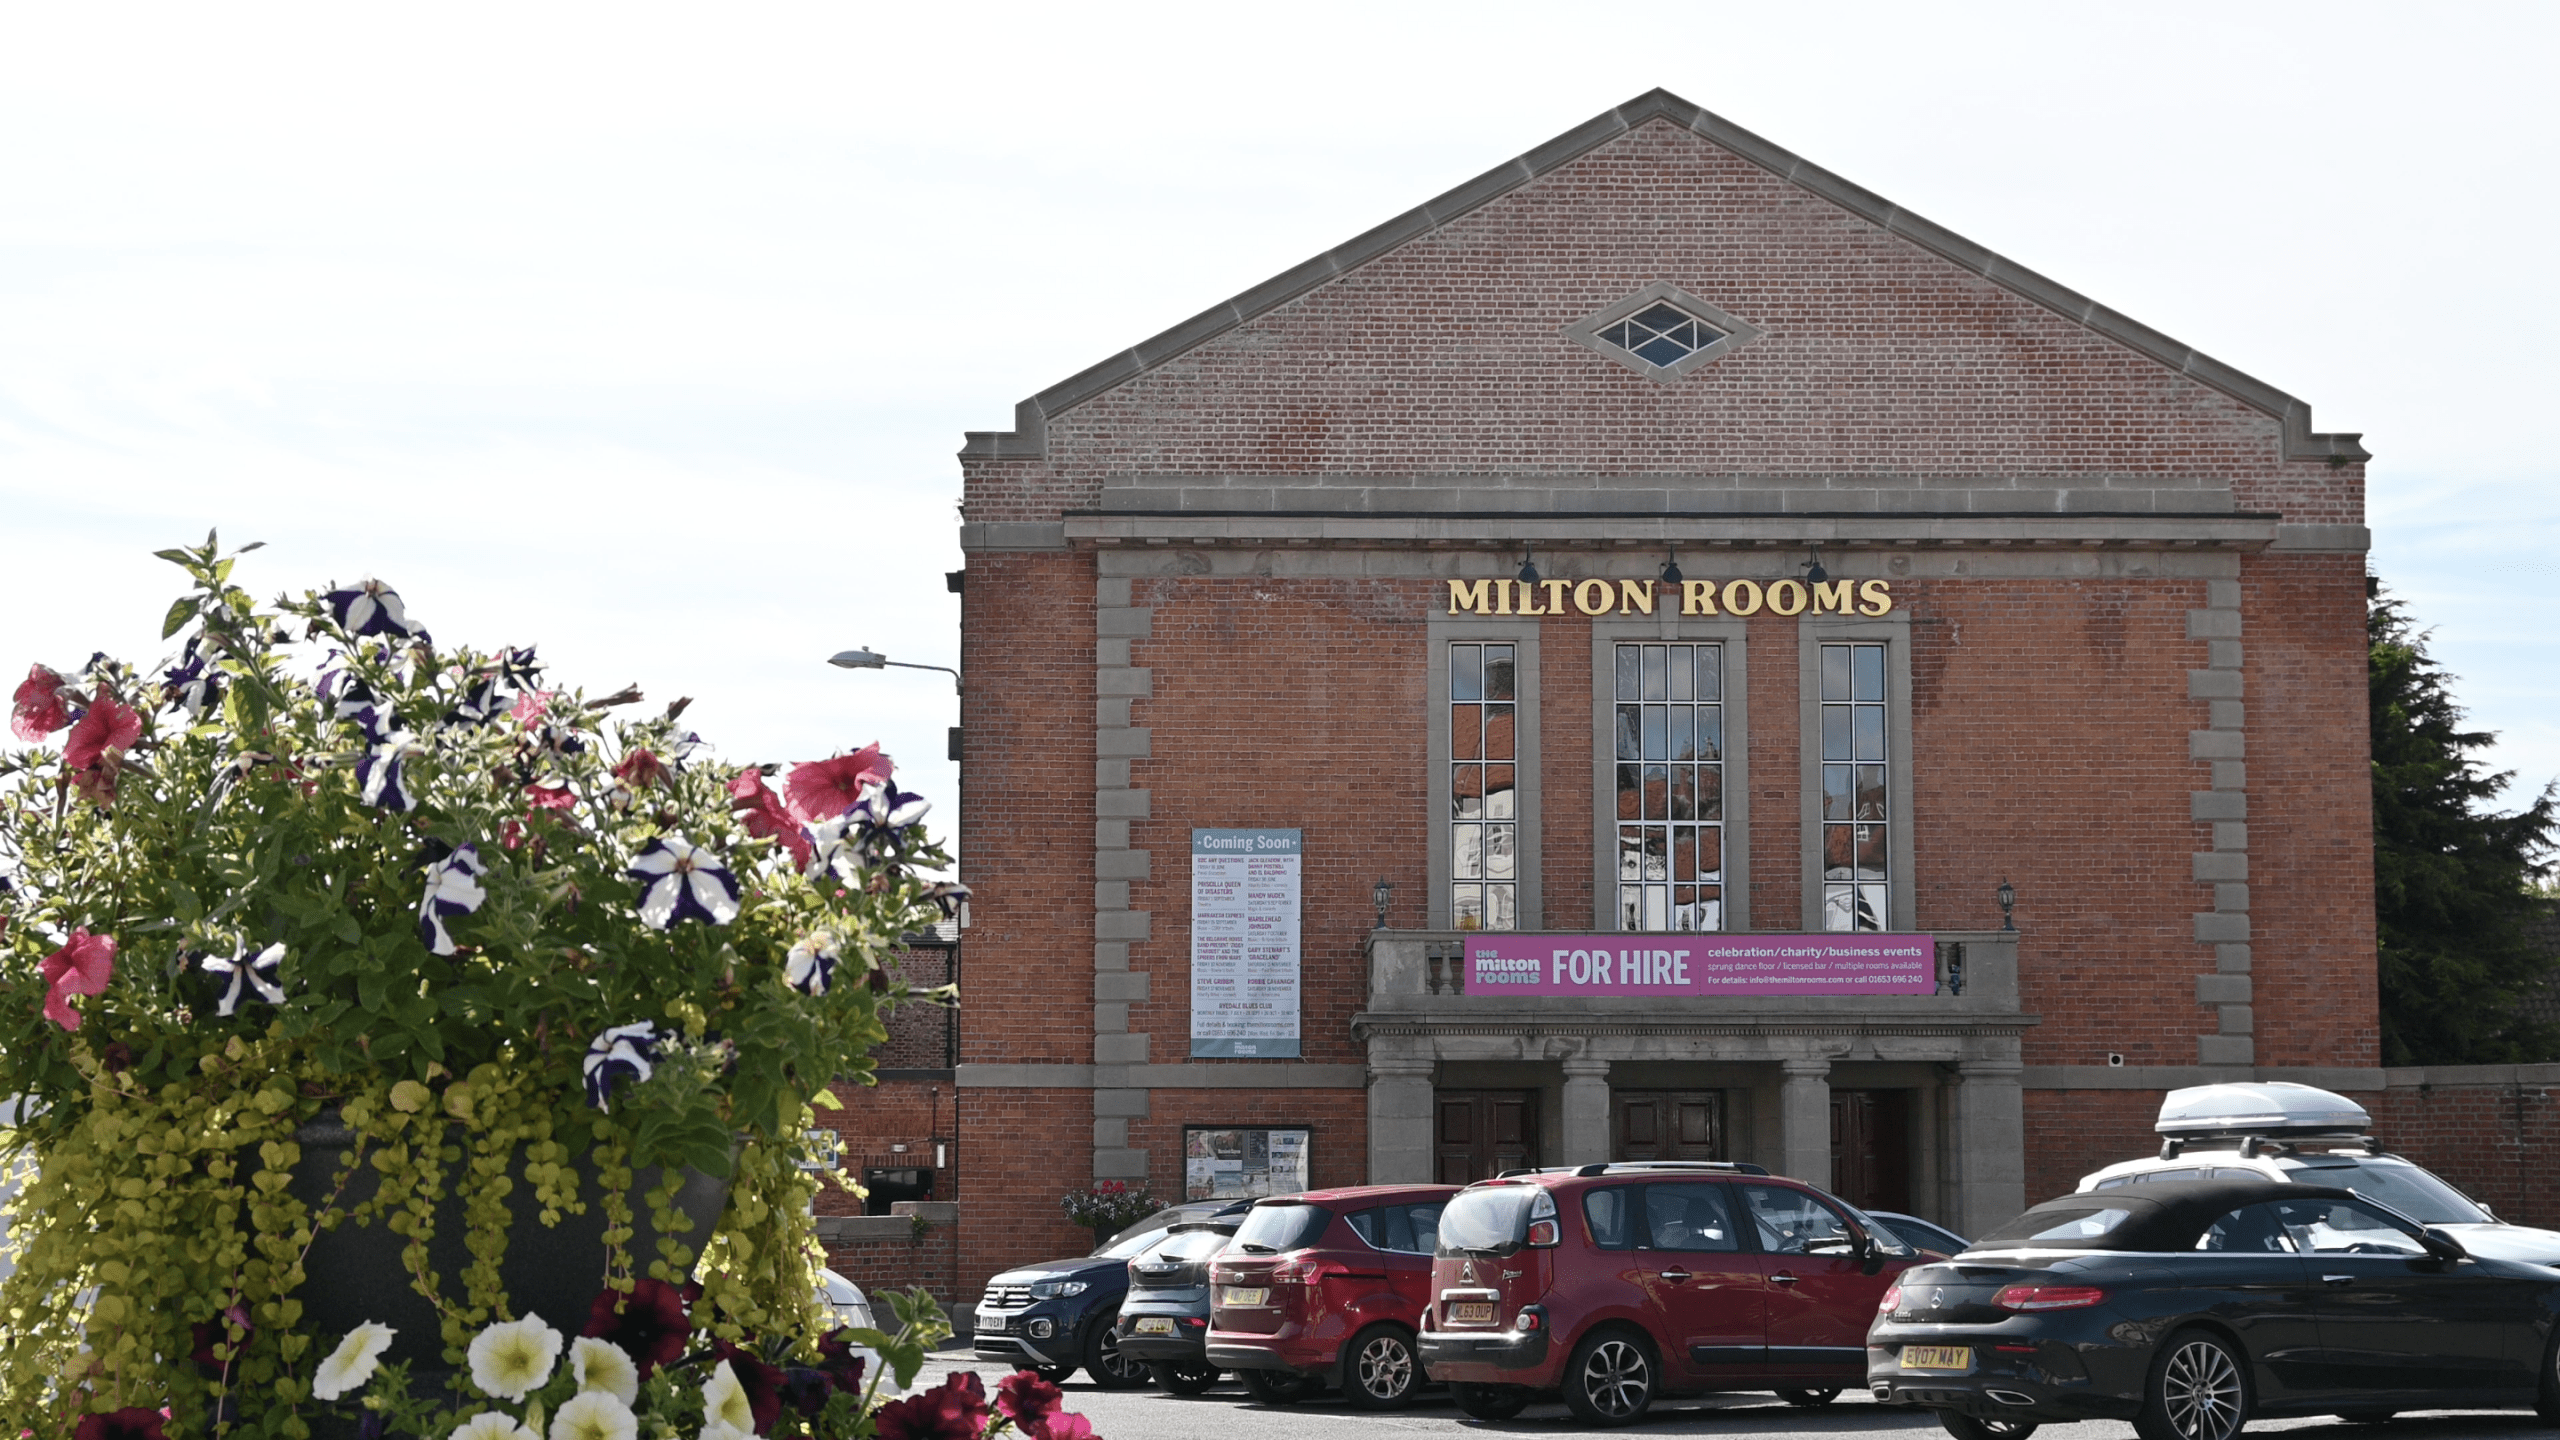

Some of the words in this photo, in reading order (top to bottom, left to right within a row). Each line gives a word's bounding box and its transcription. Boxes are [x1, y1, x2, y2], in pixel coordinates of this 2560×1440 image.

[1447, 579, 1655, 615] MILTON
[1681, 579, 1893, 616] ROOMS
[1203, 834, 1253, 852] Coming
[1257, 835, 1290, 849] Soon
[1707, 947, 1880, 958] celebration/charity/business
[1883, 947, 1922, 957] events
[1475, 959, 1541, 971] milton
[1552, 949, 1612, 985] FOR
[1620, 950, 1691, 985] HIRE
[1707, 964, 1733, 972] sprung
[1735, 962, 1757, 970] dance
[1758, 962, 1775, 970] floor
[1783, 962, 1814, 970] licensed
[1814, 962, 1827, 970] bar
[1834, 961, 1865, 971] multiple
[1890, 961, 1923, 970] available
[1475, 972, 1541, 984] rooms
[1707, 976, 1720, 984] For
[1721, 976, 1748, 984] details:
[1749, 975, 1844, 984] info@themiltonrooms.com
[1845, 976, 1853, 984] or
[1854, 975, 1867, 984] call
[1868, 975, 1891, 984] 01653
[1892, 975, 1907, 984] 696
[1907, 975, 1923, 984] 240
[1906, 1347, 1937, 1366] EV07
[1939, 1347, 1964, 1366] MAY
